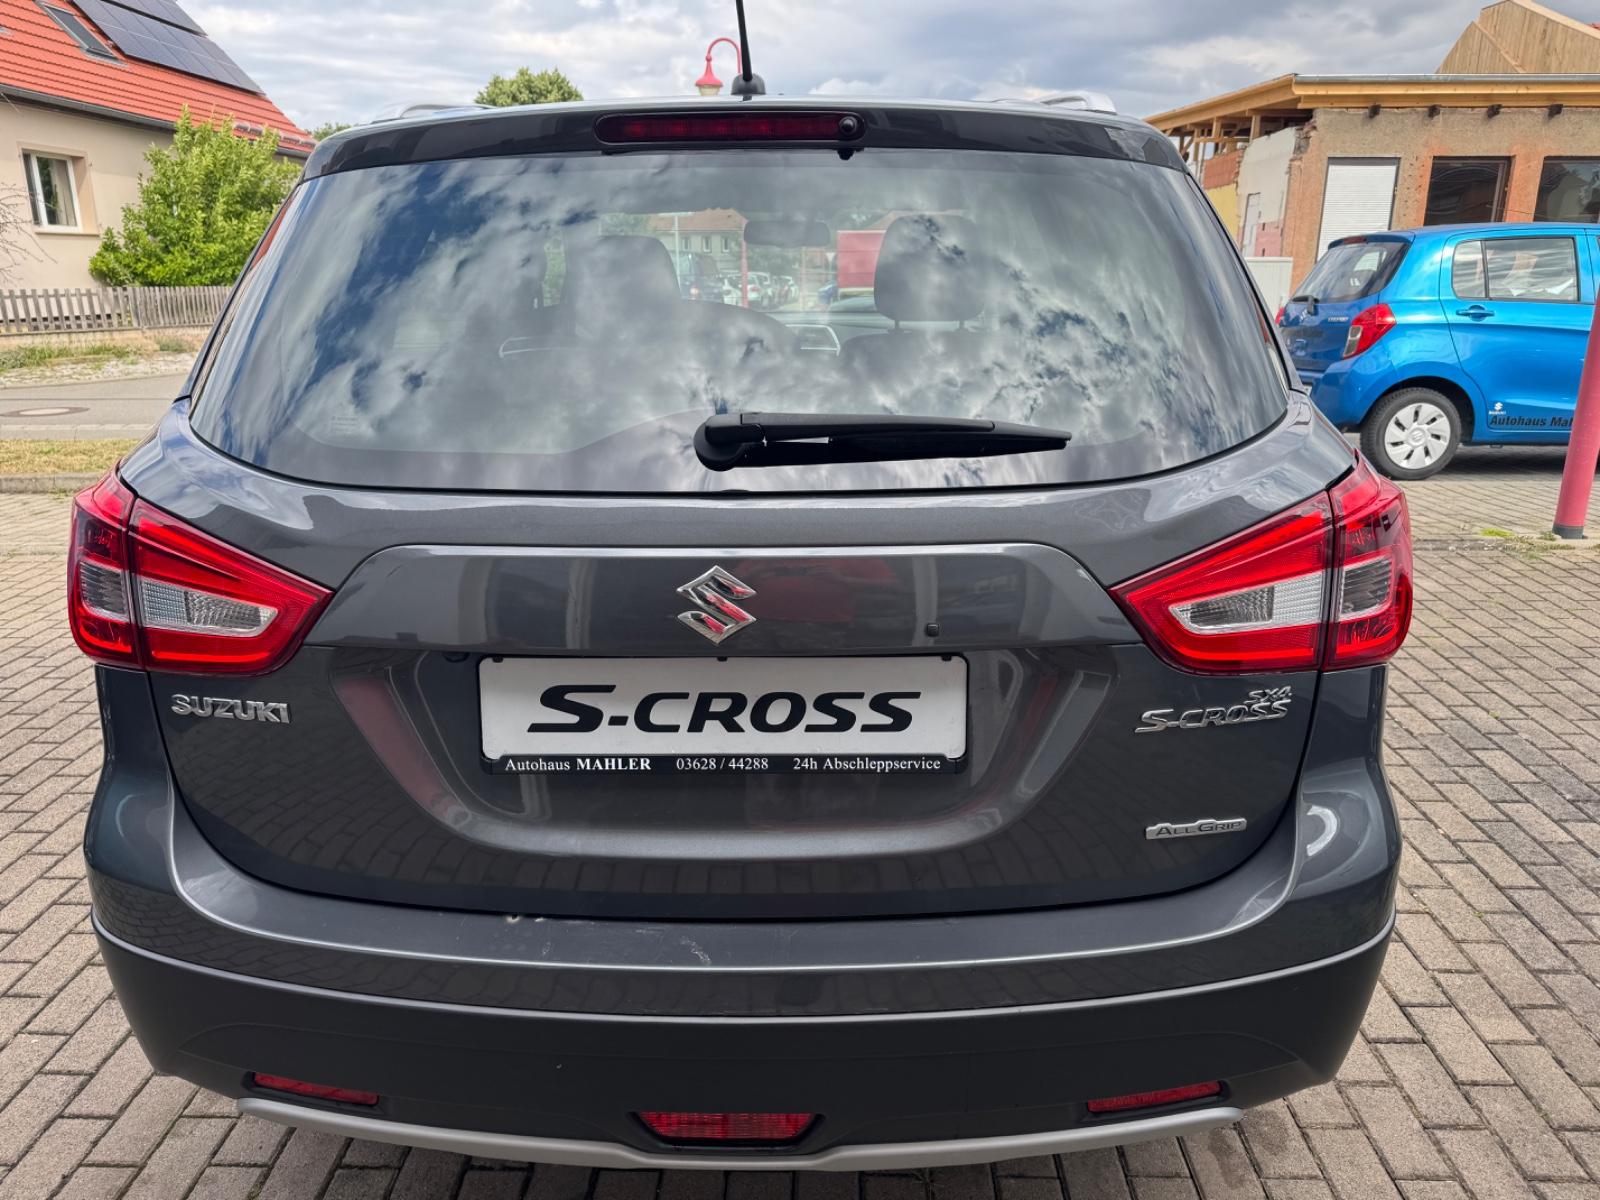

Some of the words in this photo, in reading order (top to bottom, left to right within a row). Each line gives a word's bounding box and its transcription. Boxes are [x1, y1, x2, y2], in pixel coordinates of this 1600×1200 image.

[1489, 415, 1546, 426] Autohaus
[1243, 686, 1292, 704] SX4
[171, 694, 290, 723] SUZUKI
[527, 684, 921, 733] S-CROSS
[1134, 699, 1291, 733] S-CROSS
[505, 758, 570, 771] Autohaus
[576, 758, 651, 770] MAHLER
[676, 757, 716, 770] 03628
[728, 757, 769, 770] 44288
[793, 757, 818, 770] 24h
[823, 757, 941, 773] Abschleppservice
